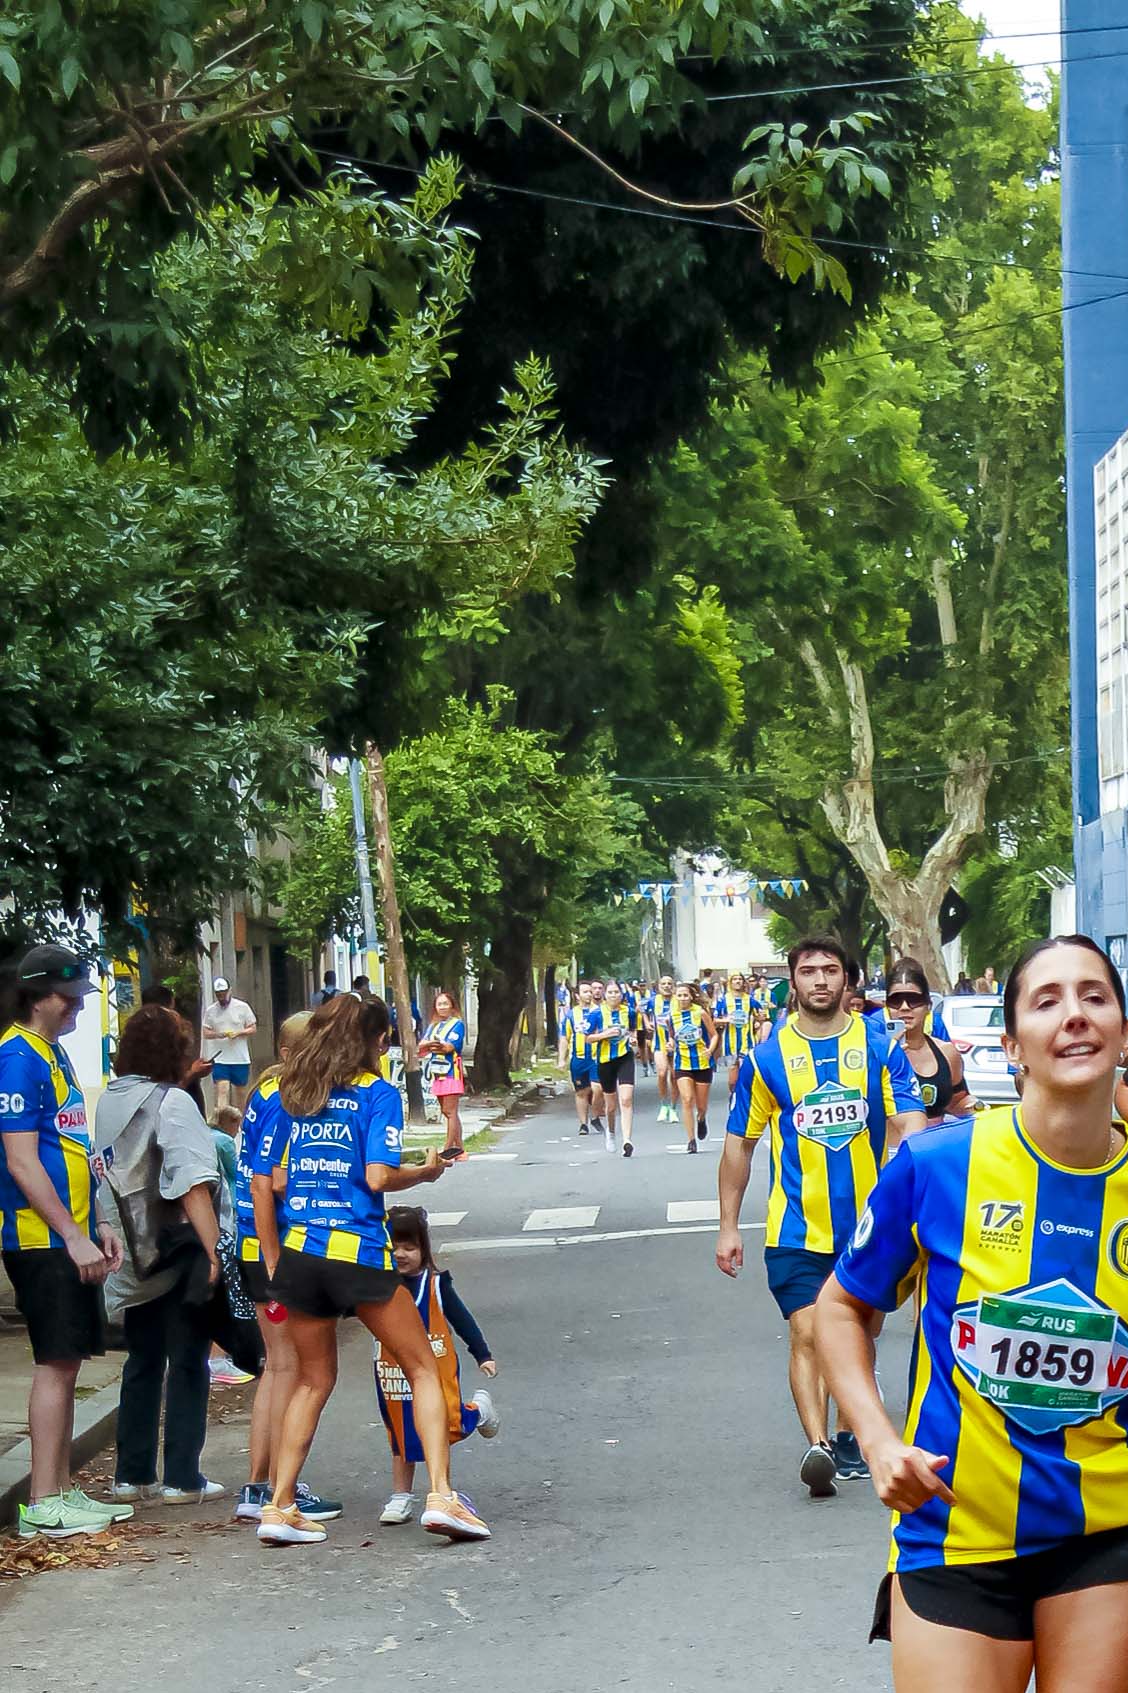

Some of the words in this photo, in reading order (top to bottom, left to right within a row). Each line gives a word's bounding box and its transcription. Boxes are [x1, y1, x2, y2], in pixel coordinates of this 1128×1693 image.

[812, 1104, 858, 1125] 2193
[301, 1122, 353, 1142] PORTA
[980, 1202, 1023, 1229] 17
[1056, 1223, 1095, 1238] express
[1041, 1316, 1078, 1333] RUS
[991, 1337, 1094, 1387] 1859
